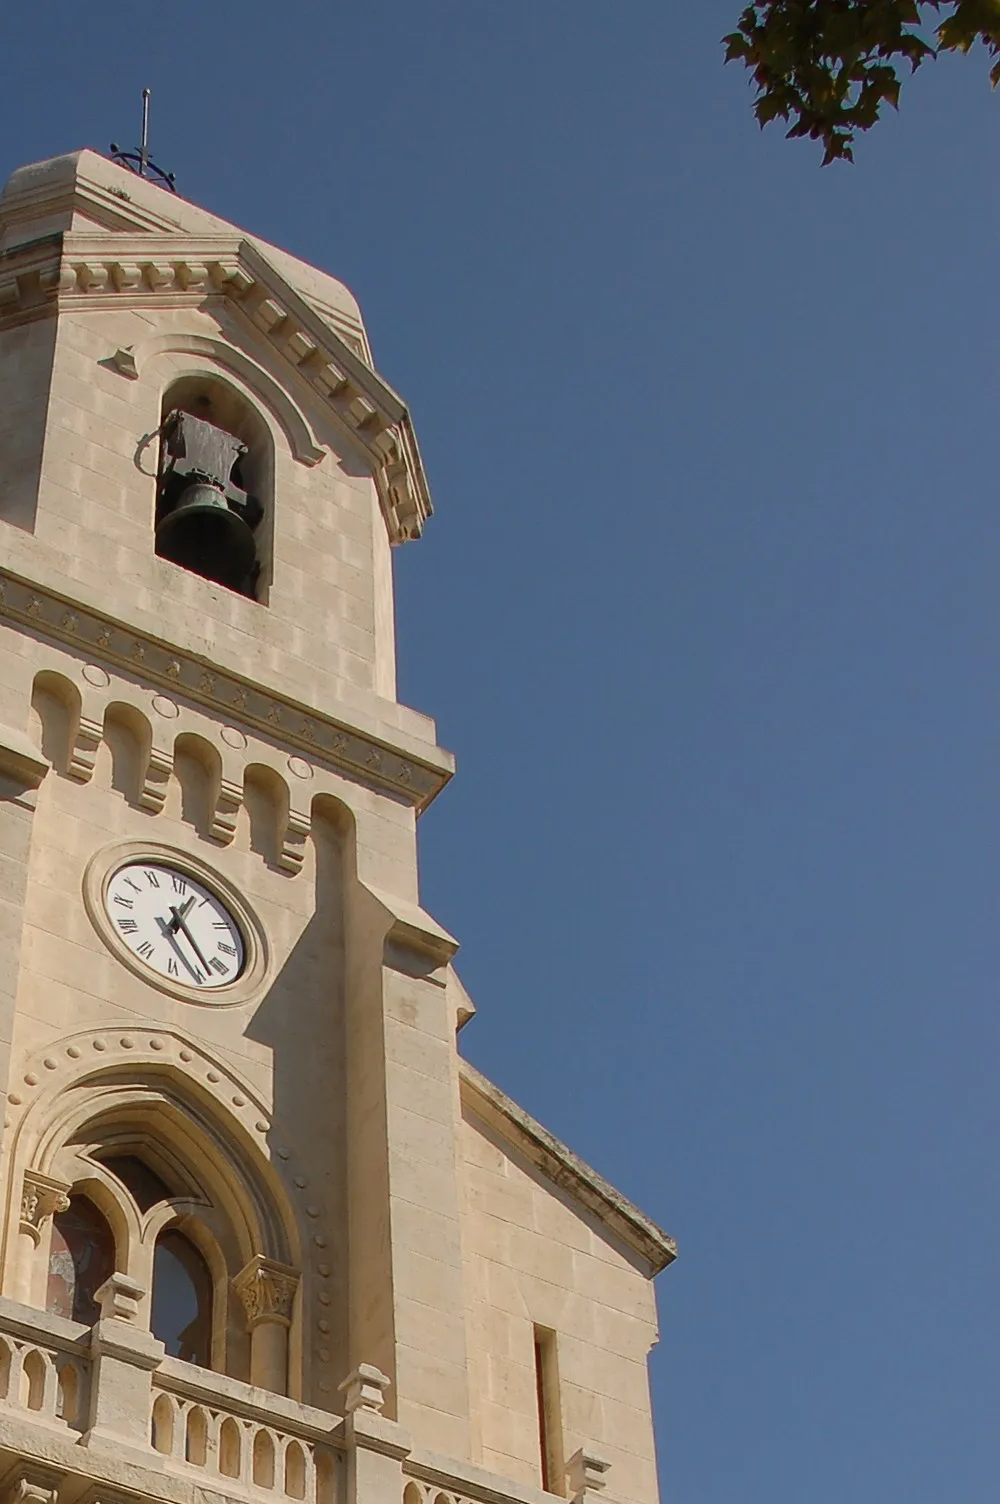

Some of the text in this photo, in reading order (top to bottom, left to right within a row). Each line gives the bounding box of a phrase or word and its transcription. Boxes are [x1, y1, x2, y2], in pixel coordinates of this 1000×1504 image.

[123, 877, 142, 895] X
[143, 871, 160, 888] XI
[170, 875, 187, 896] XII
[113, 893, 134, 909] IX
[117, 919, 139, 934] VIII
[212, 922, 231, 930] II
[136, 941, 155, 960] VII
[217, 941, 237, 957] III
[168, 958, 179, 976] VI
